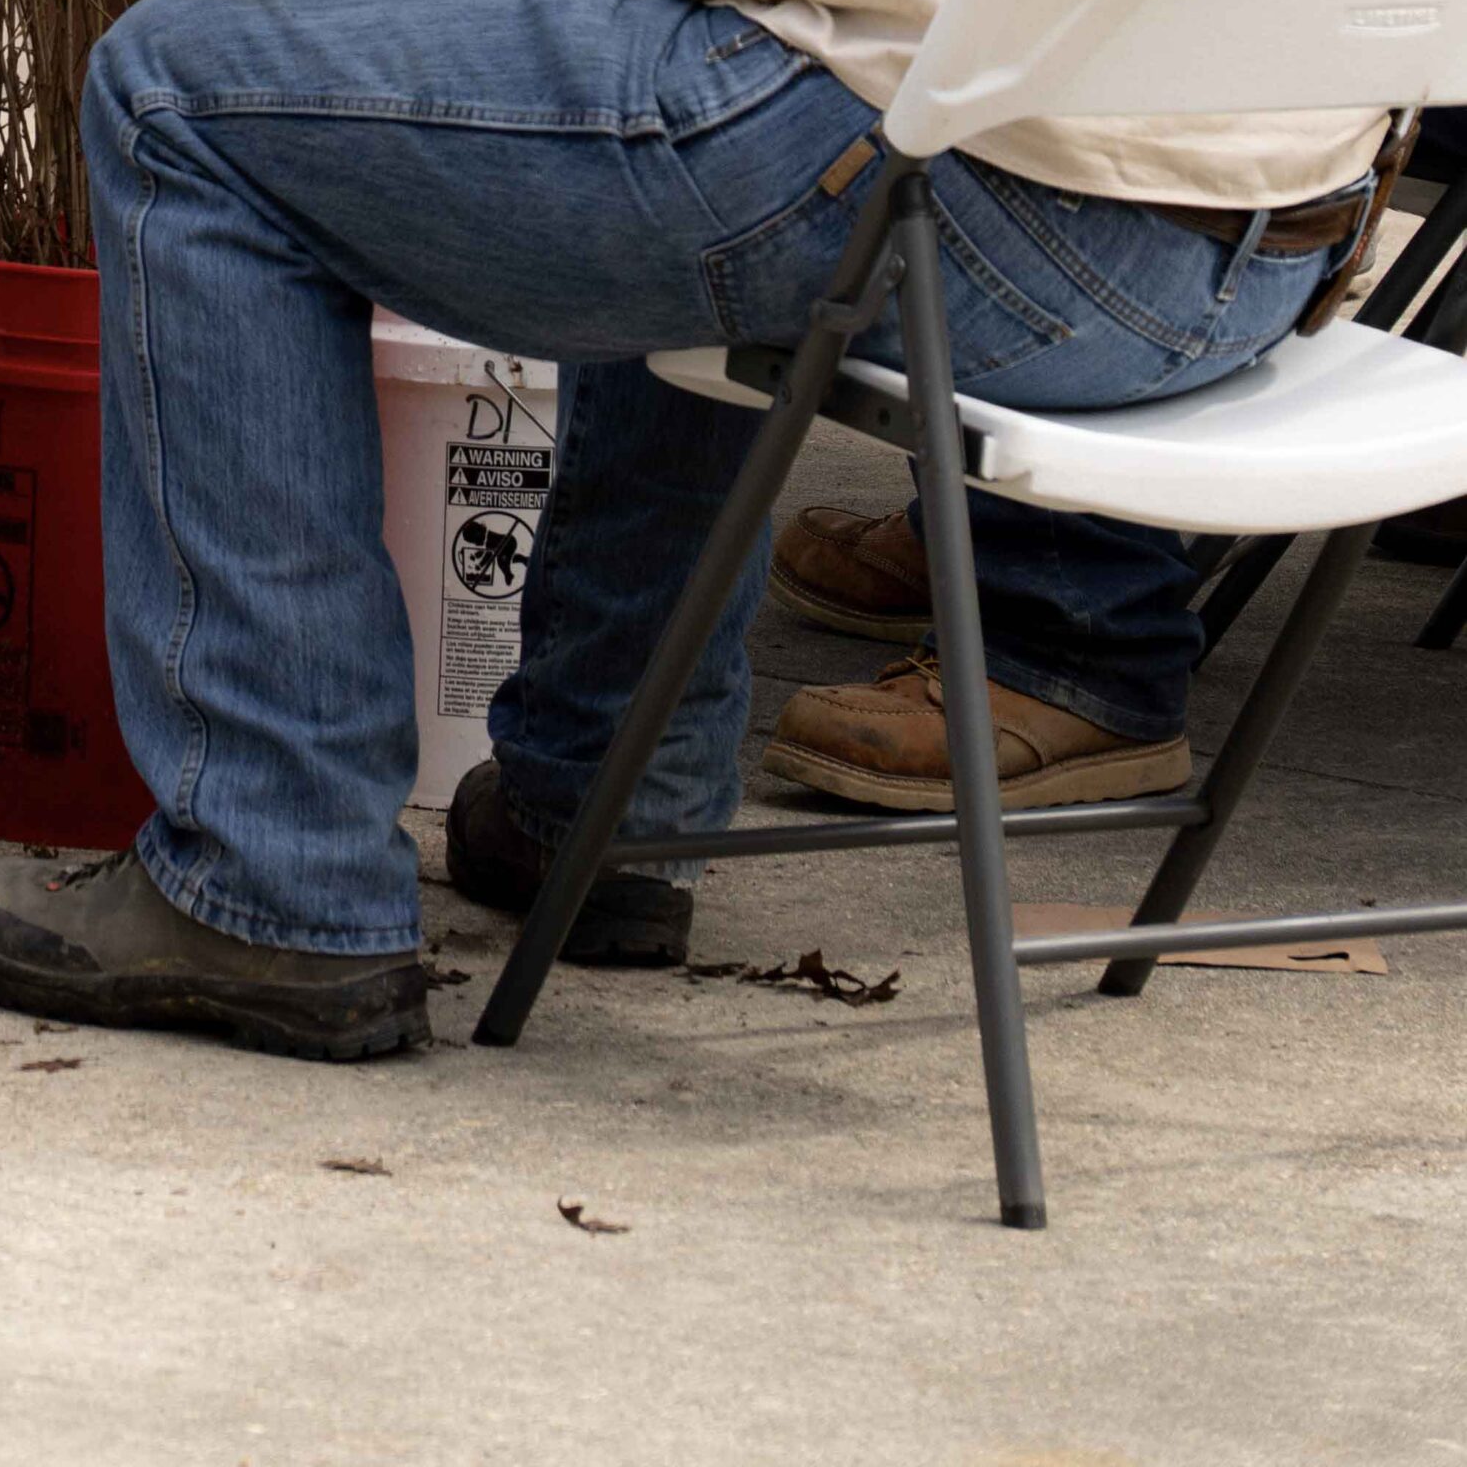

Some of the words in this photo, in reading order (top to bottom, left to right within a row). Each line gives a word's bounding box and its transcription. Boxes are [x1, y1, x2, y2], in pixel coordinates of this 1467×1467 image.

[468, 449, 543, 467] WARNING
[476, 470, 524, 487] AVISO
[468, 490, 549, 508] AVERTISSEMENT
